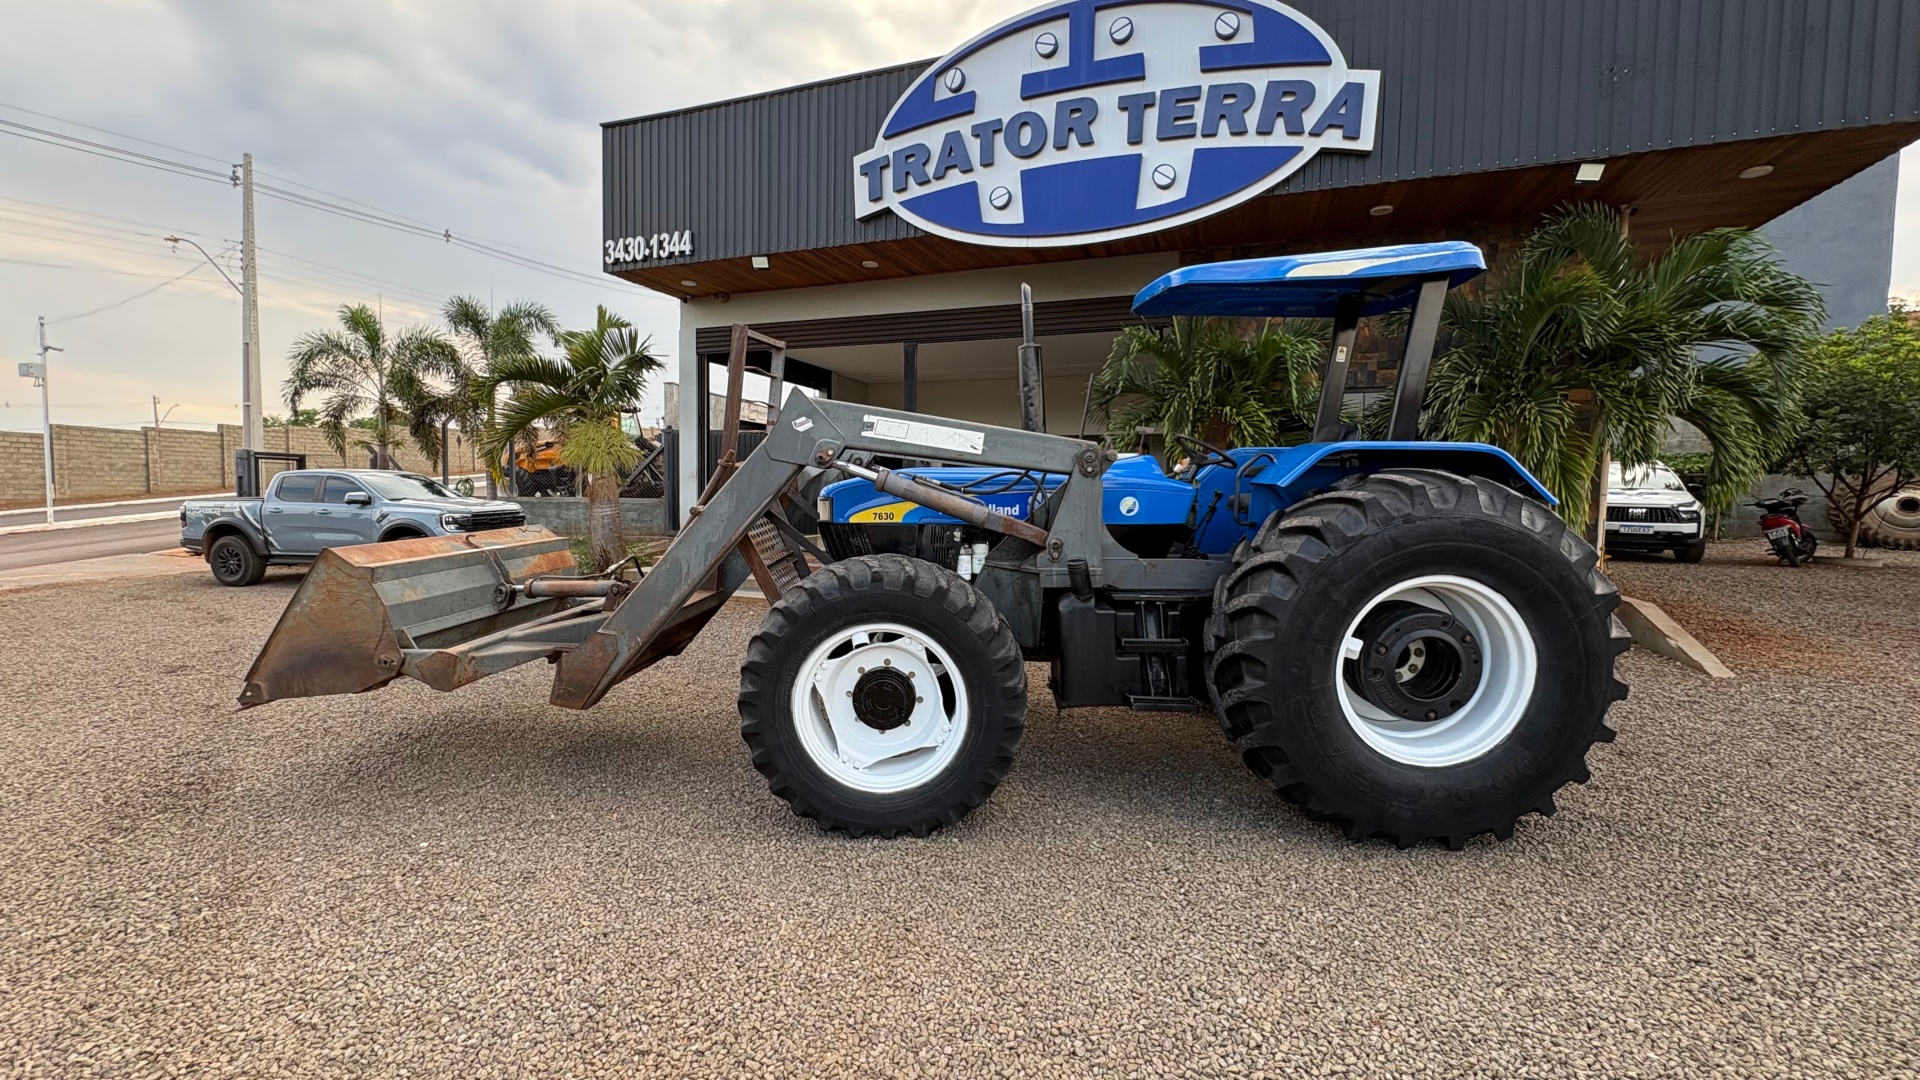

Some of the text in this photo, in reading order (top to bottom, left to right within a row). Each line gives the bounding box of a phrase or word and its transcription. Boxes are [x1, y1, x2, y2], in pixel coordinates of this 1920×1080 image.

[859, 79, 1366, 202] TRATOR TERRA
[604, 229, 693, 264] 3430-1344
[988, 504, 1020, 516] lland
[1628, 508, 1647, 519] FIAT
[872, 512, 895, 521] 7630
